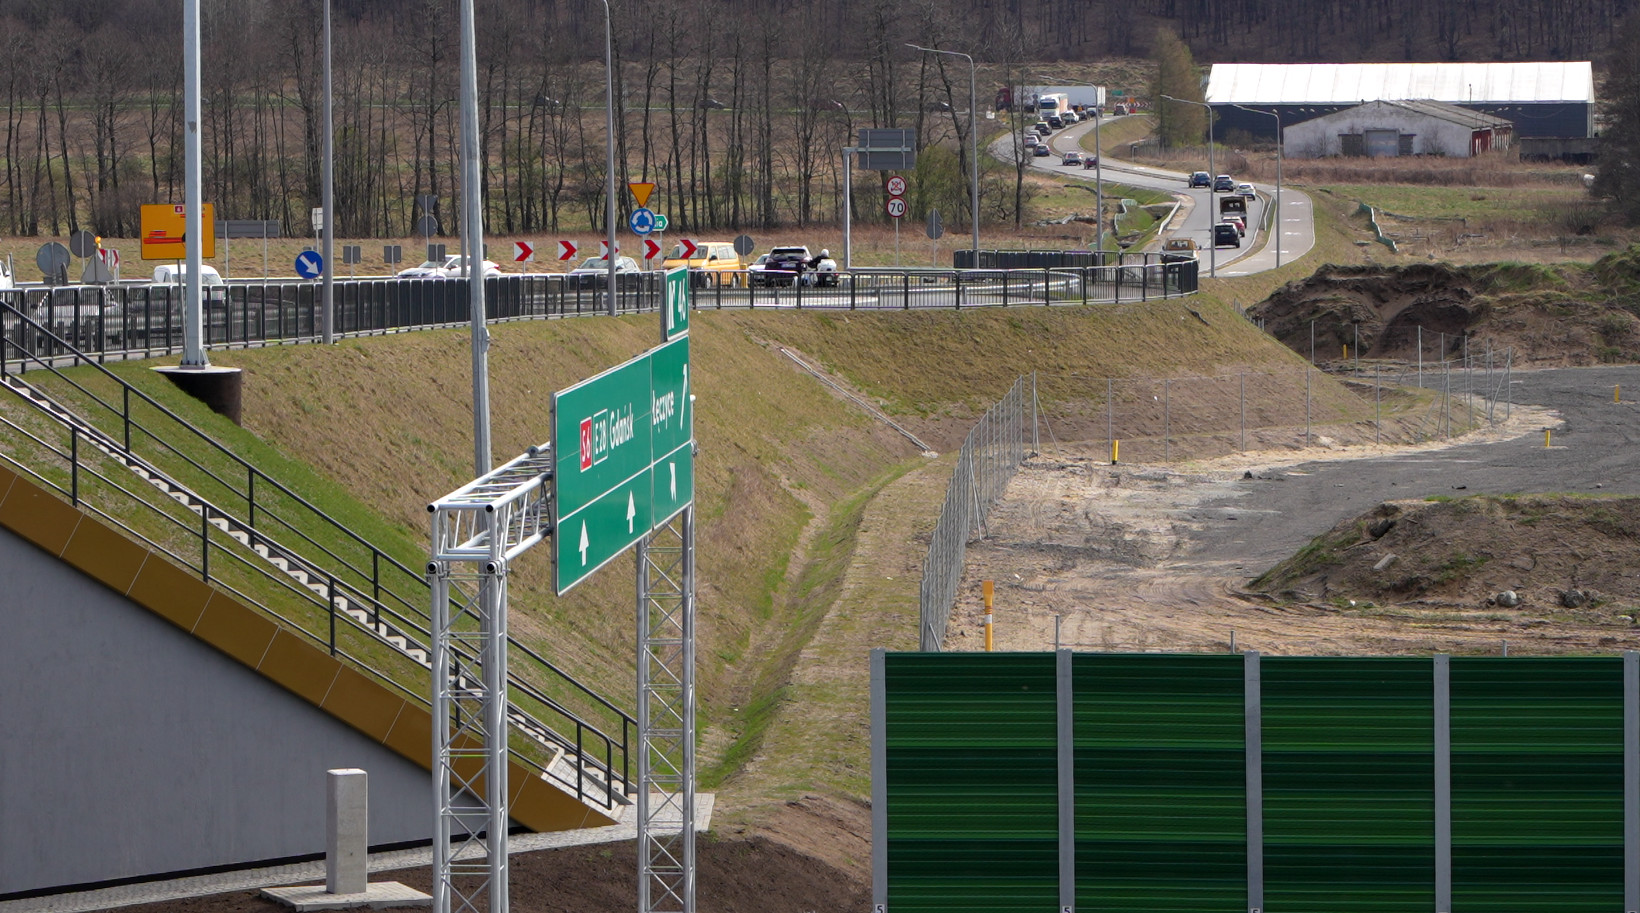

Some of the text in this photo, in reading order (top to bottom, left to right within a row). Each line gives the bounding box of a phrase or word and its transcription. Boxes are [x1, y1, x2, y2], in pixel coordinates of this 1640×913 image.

[890, 203, 903, 213] 70
[678, 279, 687, 322] 46
[610, 403, 634, 450] Gdańsk
[652, 390, 674, 433] Łęczyce
